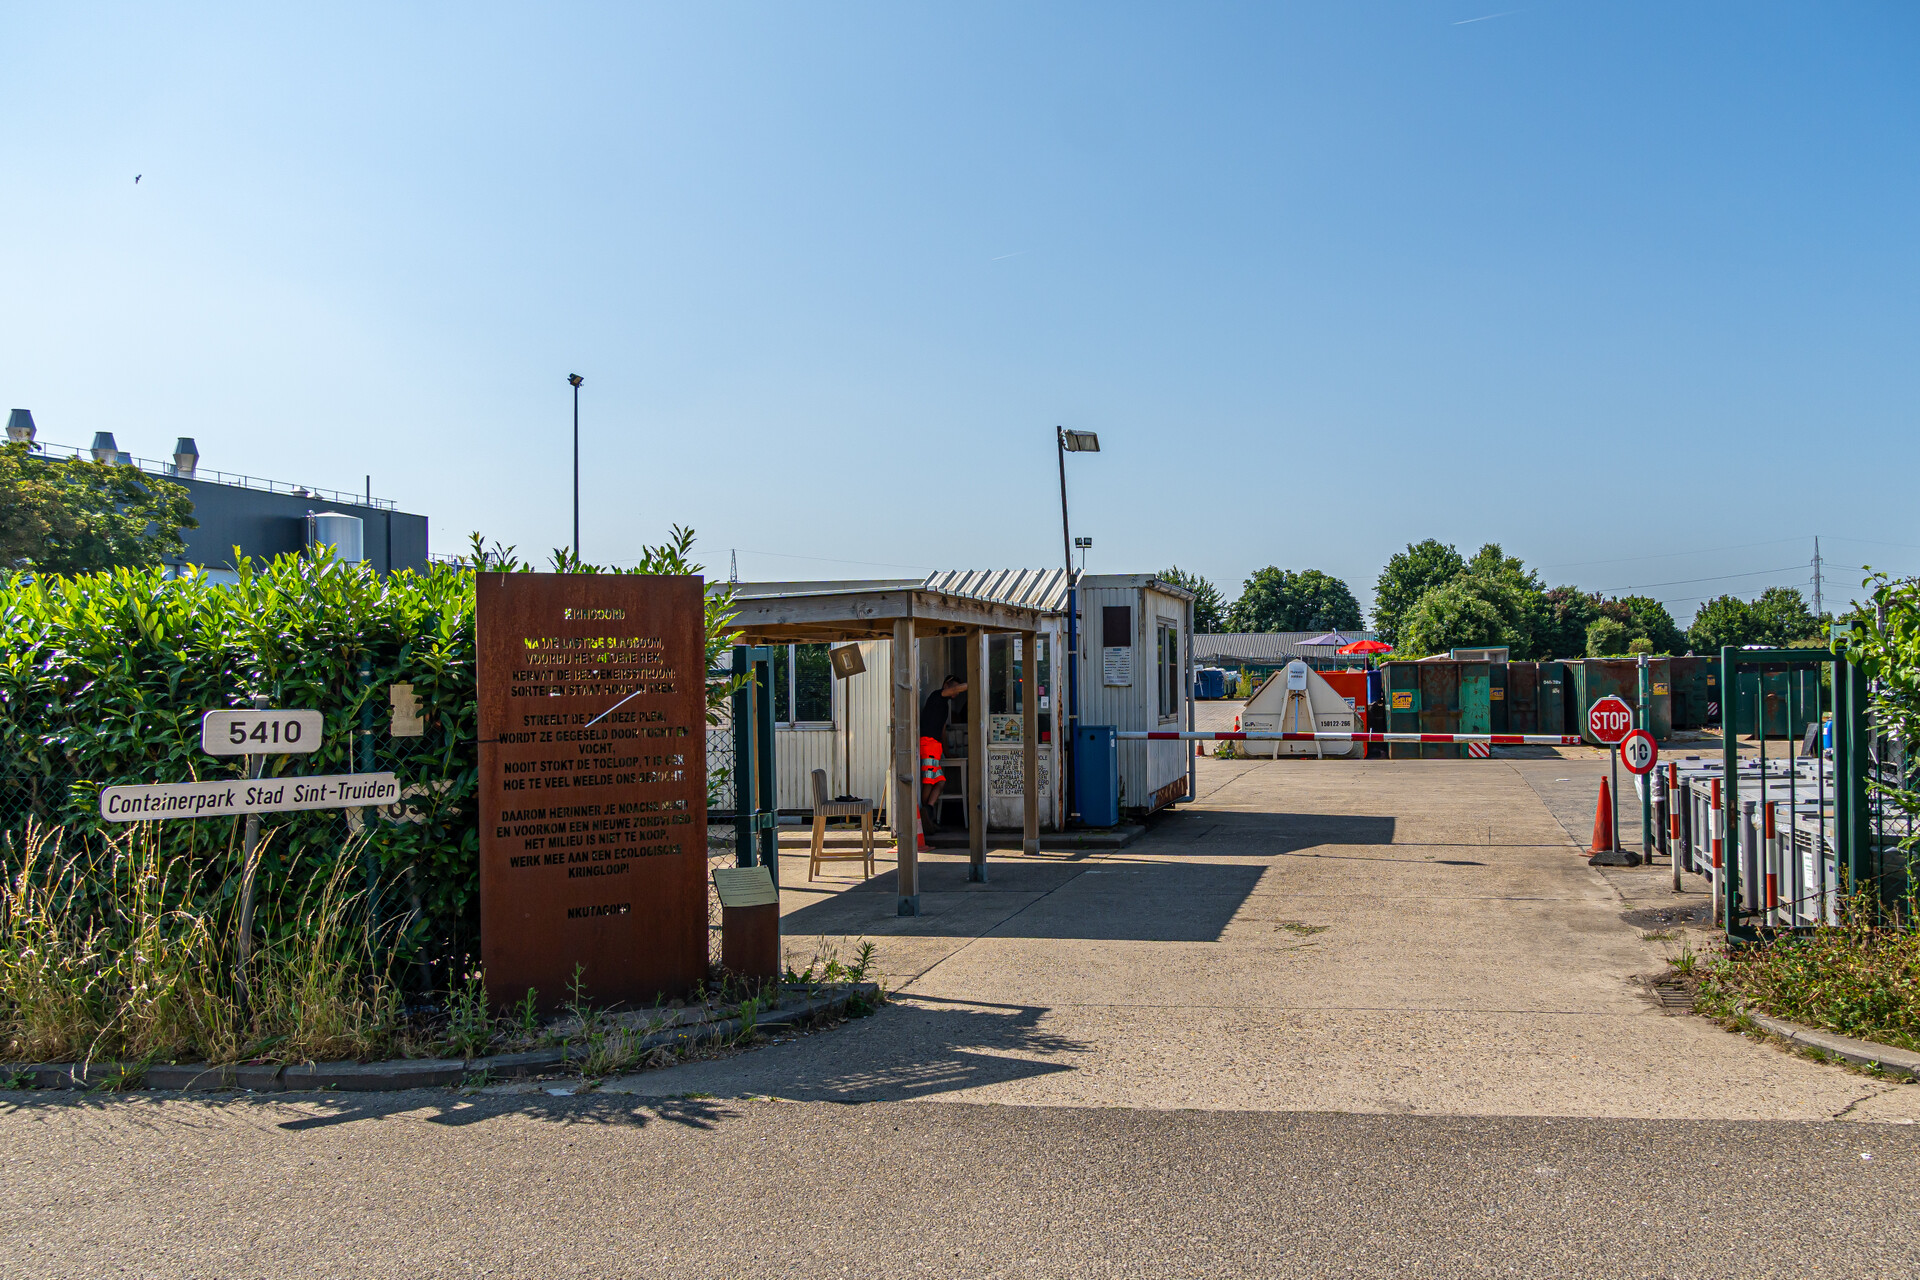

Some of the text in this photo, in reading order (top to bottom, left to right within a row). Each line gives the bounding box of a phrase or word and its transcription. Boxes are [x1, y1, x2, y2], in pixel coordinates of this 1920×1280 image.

[524, 637, 540, 650] NA
[562, 637, 605, 650] LASTIGE
[526, 653, 572, 665] VOORBIJ
[574, 652, 595, 665] HET
[640, 651, 664, 666] HEK,
[512, 669, 554, 682] HERVAT
[557, 669, 572, 681] DE
[511, 685, 567, 697] SORTEREN
[569, 684, 602, 697] STAAT
[604, 683, 633, 696] HOOG
[635, 683, 647, 695] IN
[523, 714, 569, 727] STREELT
[571, 713, 585, 725] DE
[611, 711, 637, 723] DEZE
[639, 711, 667, 723] PLEK,
[1591, 711, 1629, 730] STOP
[229, 720, 302, 745] 5410
[499, 725, 689, 744] WORDT ZE GEGESELD DOOR TOCHT EN
[578, 742, 616, 755] VOCHT,
[1629, 743, 1648, 761] 10
[504, 761, 537, 773] NOOIT
[540, 759, 574, 772] STOKT
[577, 758, 591, 770] DE
[653, 755, 664, 767] IS
[503, 778, 526, 791] HOE
[528, 777, 542, 789] TE
[544, 776, 570, 788] VEEL
[572, 773, 614, 787] WEELDE
[616, 772, 637, 785] ONS
[108, 780, 397, 815] Containerpark Stad Sint-Truiden
[502, 808, 547, 822] DAAROM
[549, 804, 602, 819] HERINNER
[604, 803, 616, 815] JE
[619, 801, 660, 814] NOACHS
[496, 826, 511, 838] EN
[514, 822, 567, 837] VOORKOM
[569, 820, 590, 833] EEN
[592, 817, 631, 831] NIEUWE
[525, 828, 670, 850] HET MILIEU IS NIET TE KOOP,
[510, 844, 682, 868] WERK MEE AAN EEN ECOLOGISCHE
[568, 863, 630, 879] KRINGLOOP!
